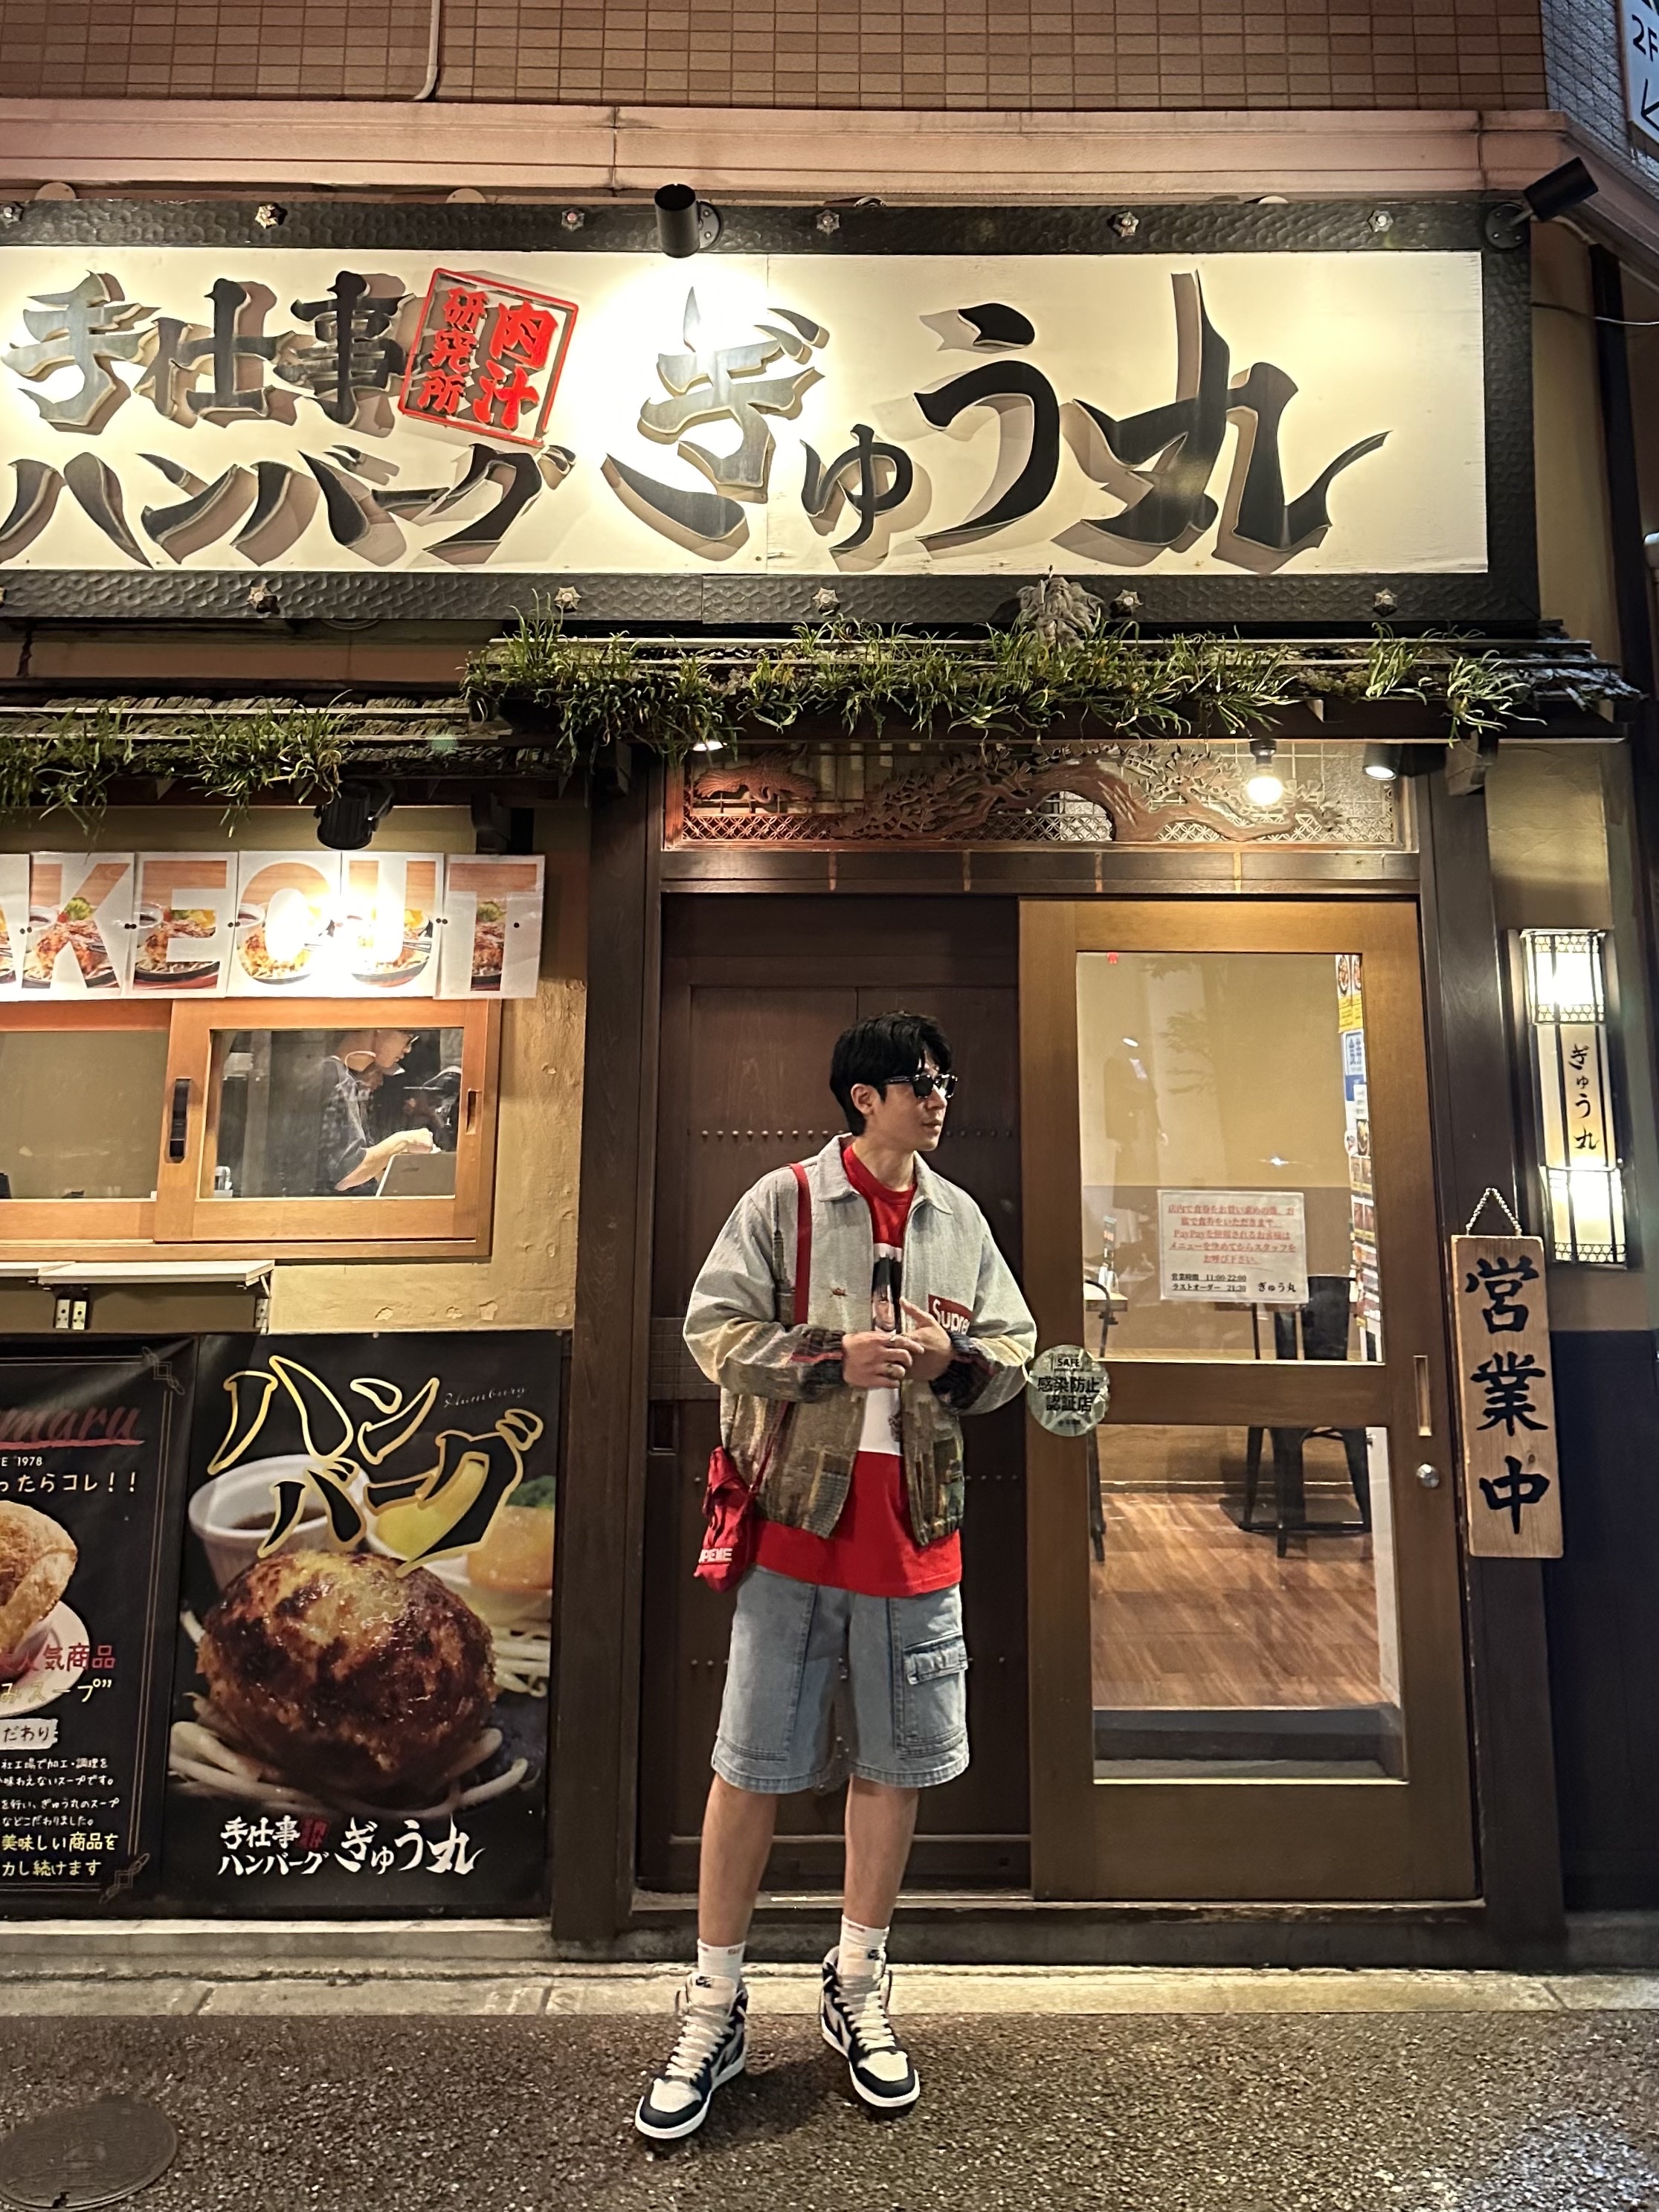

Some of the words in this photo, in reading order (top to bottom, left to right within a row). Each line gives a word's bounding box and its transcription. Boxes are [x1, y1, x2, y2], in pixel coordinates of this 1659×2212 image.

[1631, 14, 1658, 62] 2F
[0, 269, 421, 437] 手仕事
[417, 286, 489, 413] 研究所
[472, 300, 559, 431] 肉汁
[604, 269, 1393, 571] ぎゅう丸
[0, 442, 579, 569] ハンバーグ
[0, 860, 537, 992] KEOUT
[1568, 1043, 1600, 1150] ぎゅう丸
[1258, 1282, 1297, 1292] ぎゅう丸
[1057, 1358, 1080, 1367] SAFE
[1037, 1376, 1100, 1393] 感染防止
[1046, 1394, 1094, 1412] 認証店
[1465, 1256, 1550, 1535] 営業中
[17, 1456, 42, 1466] 1978
[0, 1774, 114, 1787] 味わえないスープです。
[1, 1831, 119, 1852] 美味しい商品を
[220, 1814, 301, 1850] 手仕事
[334, 1813, 486, 1876] ぎゅう丸
[1, 1859, 102, 1877] 力し続けます
[217, 1851, 329, 1876] ハンバーグ
